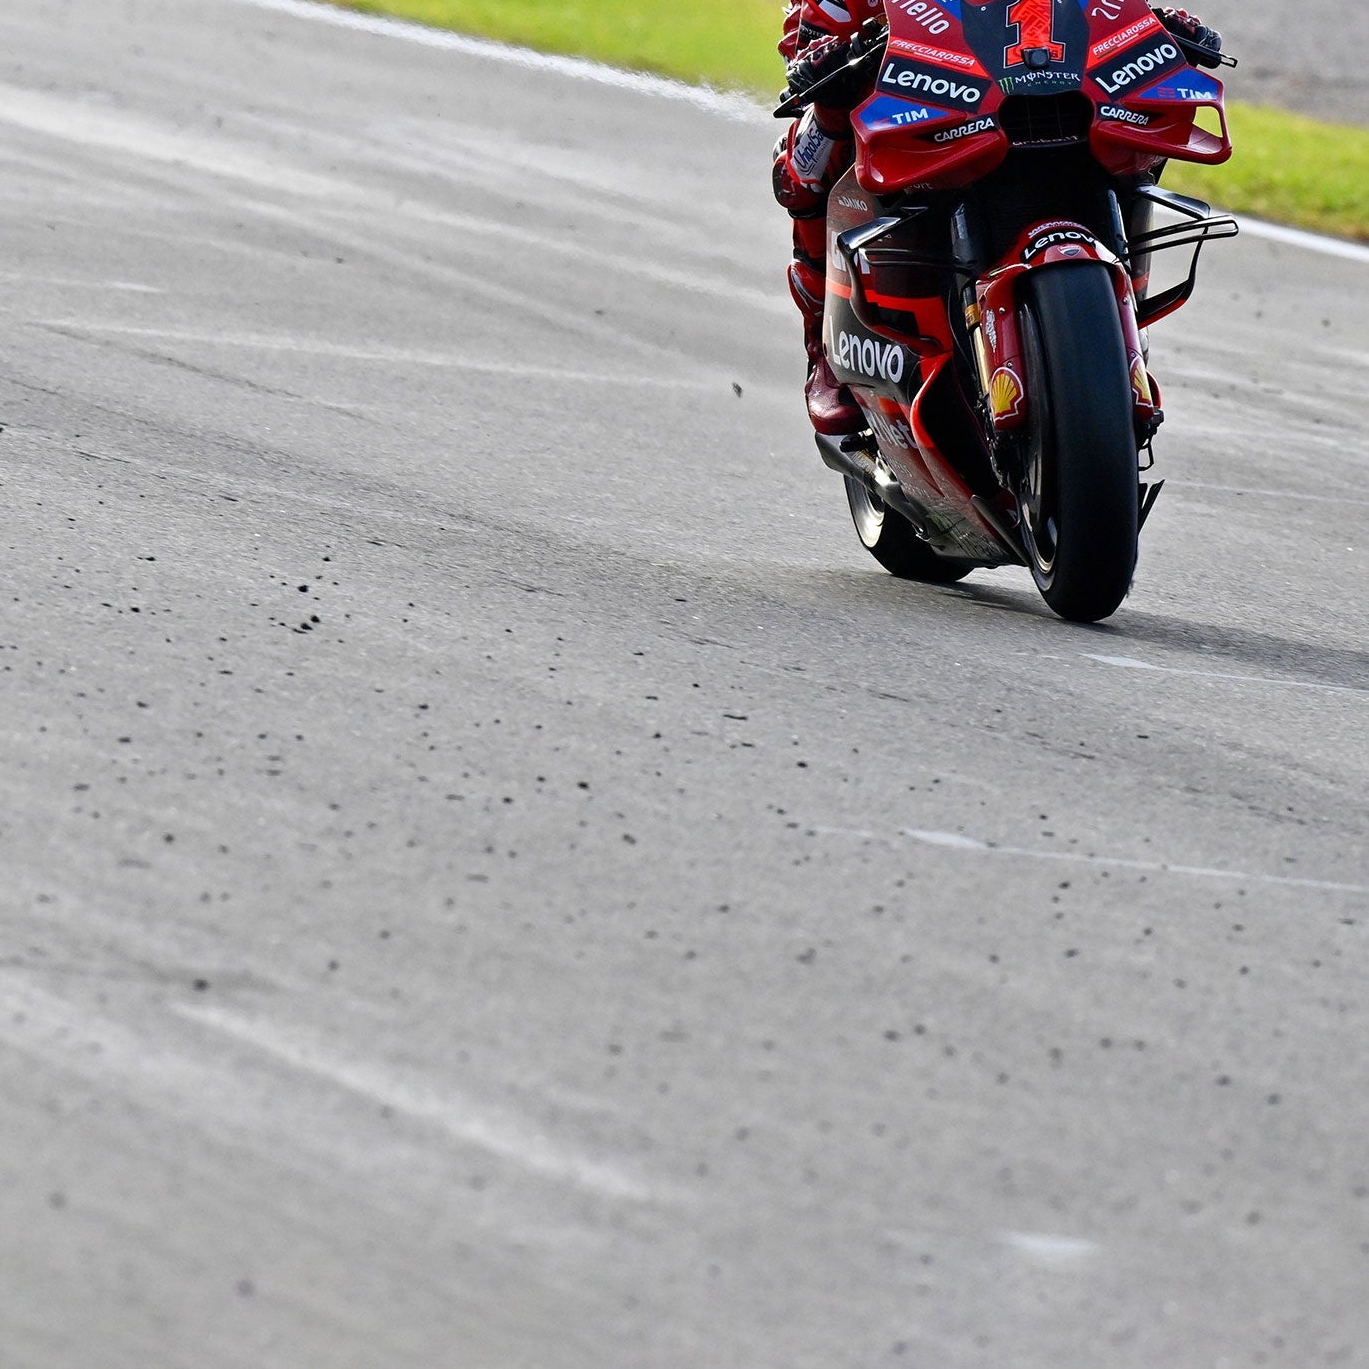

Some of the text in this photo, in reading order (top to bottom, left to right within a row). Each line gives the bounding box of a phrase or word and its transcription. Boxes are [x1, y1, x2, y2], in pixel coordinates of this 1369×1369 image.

[1092, 17, 1157, 56] FRECCIAROSSA
[890, 39, 976, 67] FRECCIAROSSA
[1015, 69, 1081, 84] MONSTER
[1095, 43, 1178, 94] Lenovo
[881, 63, 981, 103] Lenovo
[1177, 87, 1213, 100] TIM
[892, 108, 929, 125] TIM
[1100, 105, 1150, 126] CARRERA
[934, 117, 995, 143] CARRERA
[1024, 231, 1095, 260] Lenov
[829, 315, 904, 384] Lenovo
